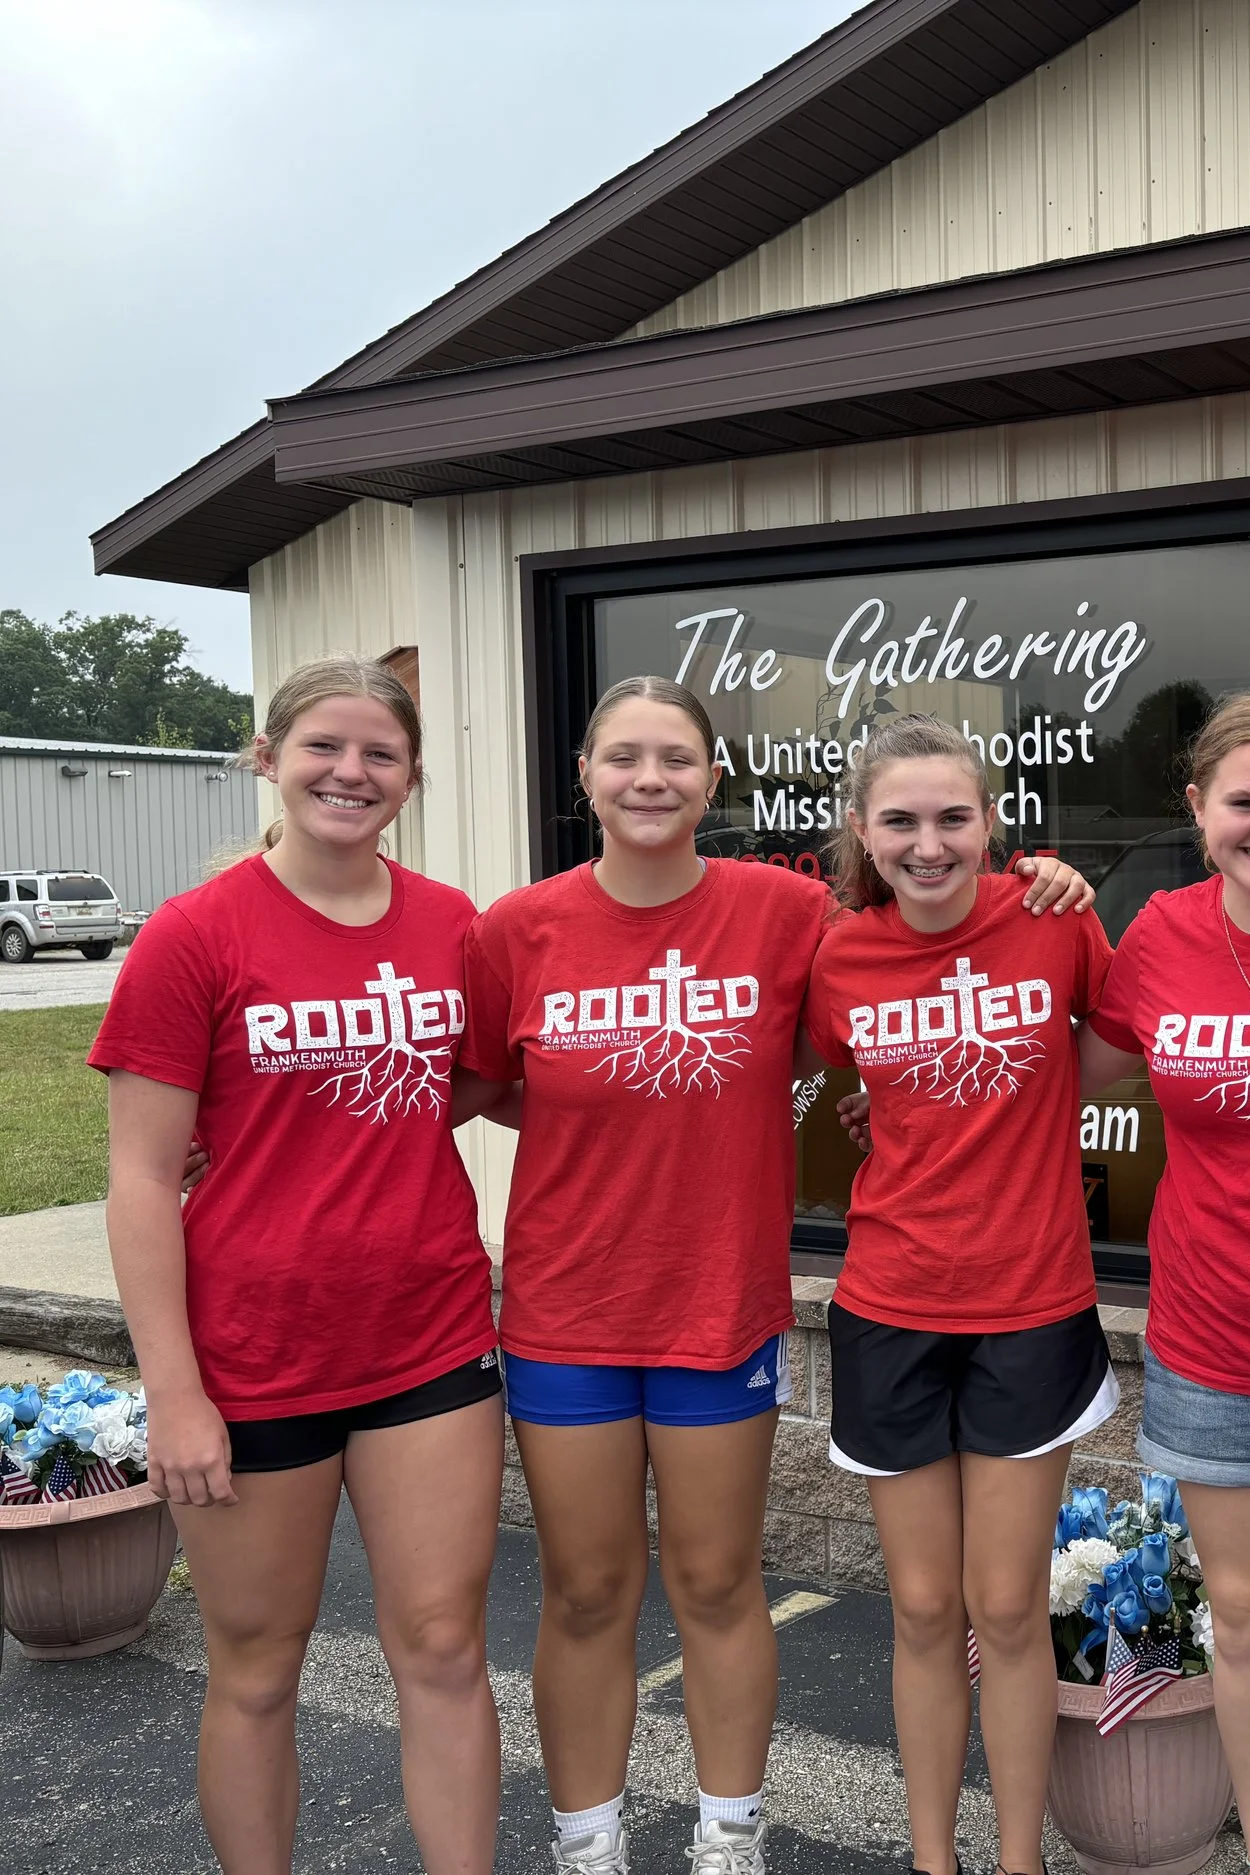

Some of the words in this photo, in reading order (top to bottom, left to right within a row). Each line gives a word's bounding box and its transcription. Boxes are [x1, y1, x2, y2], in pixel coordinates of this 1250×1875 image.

[674, 607, 783, 696] The
[826, 596, 1147, 719] Gathering
[538, 948, 760, 1035] ROOTED
[244, 961, 465, 1054] ROOTED
[848, 956, 1053, 1049] ROOTED
[538, 1030, 641, 1045] FRANKENMUTH
[562, 1042, 607, 1050] METHODIST
[609, 1039, 641, 1048] CHURCH
[250, 1049, 366, 1067] FRANKENMUTH
[908, 1051, 939, 1061] CHURCH
[1151, 1054, 1248, 1072] FRANKENMUTH
[252, 1066, 280, 1074] UNITED
[282, 1062, 331, 1073] METHODIST
[333, 1060, 367, 1069] CHURCH
[1169, 1070, 1213, 1078] METHODIST
[1216, 1069, 1249, 1078] CHURCH
